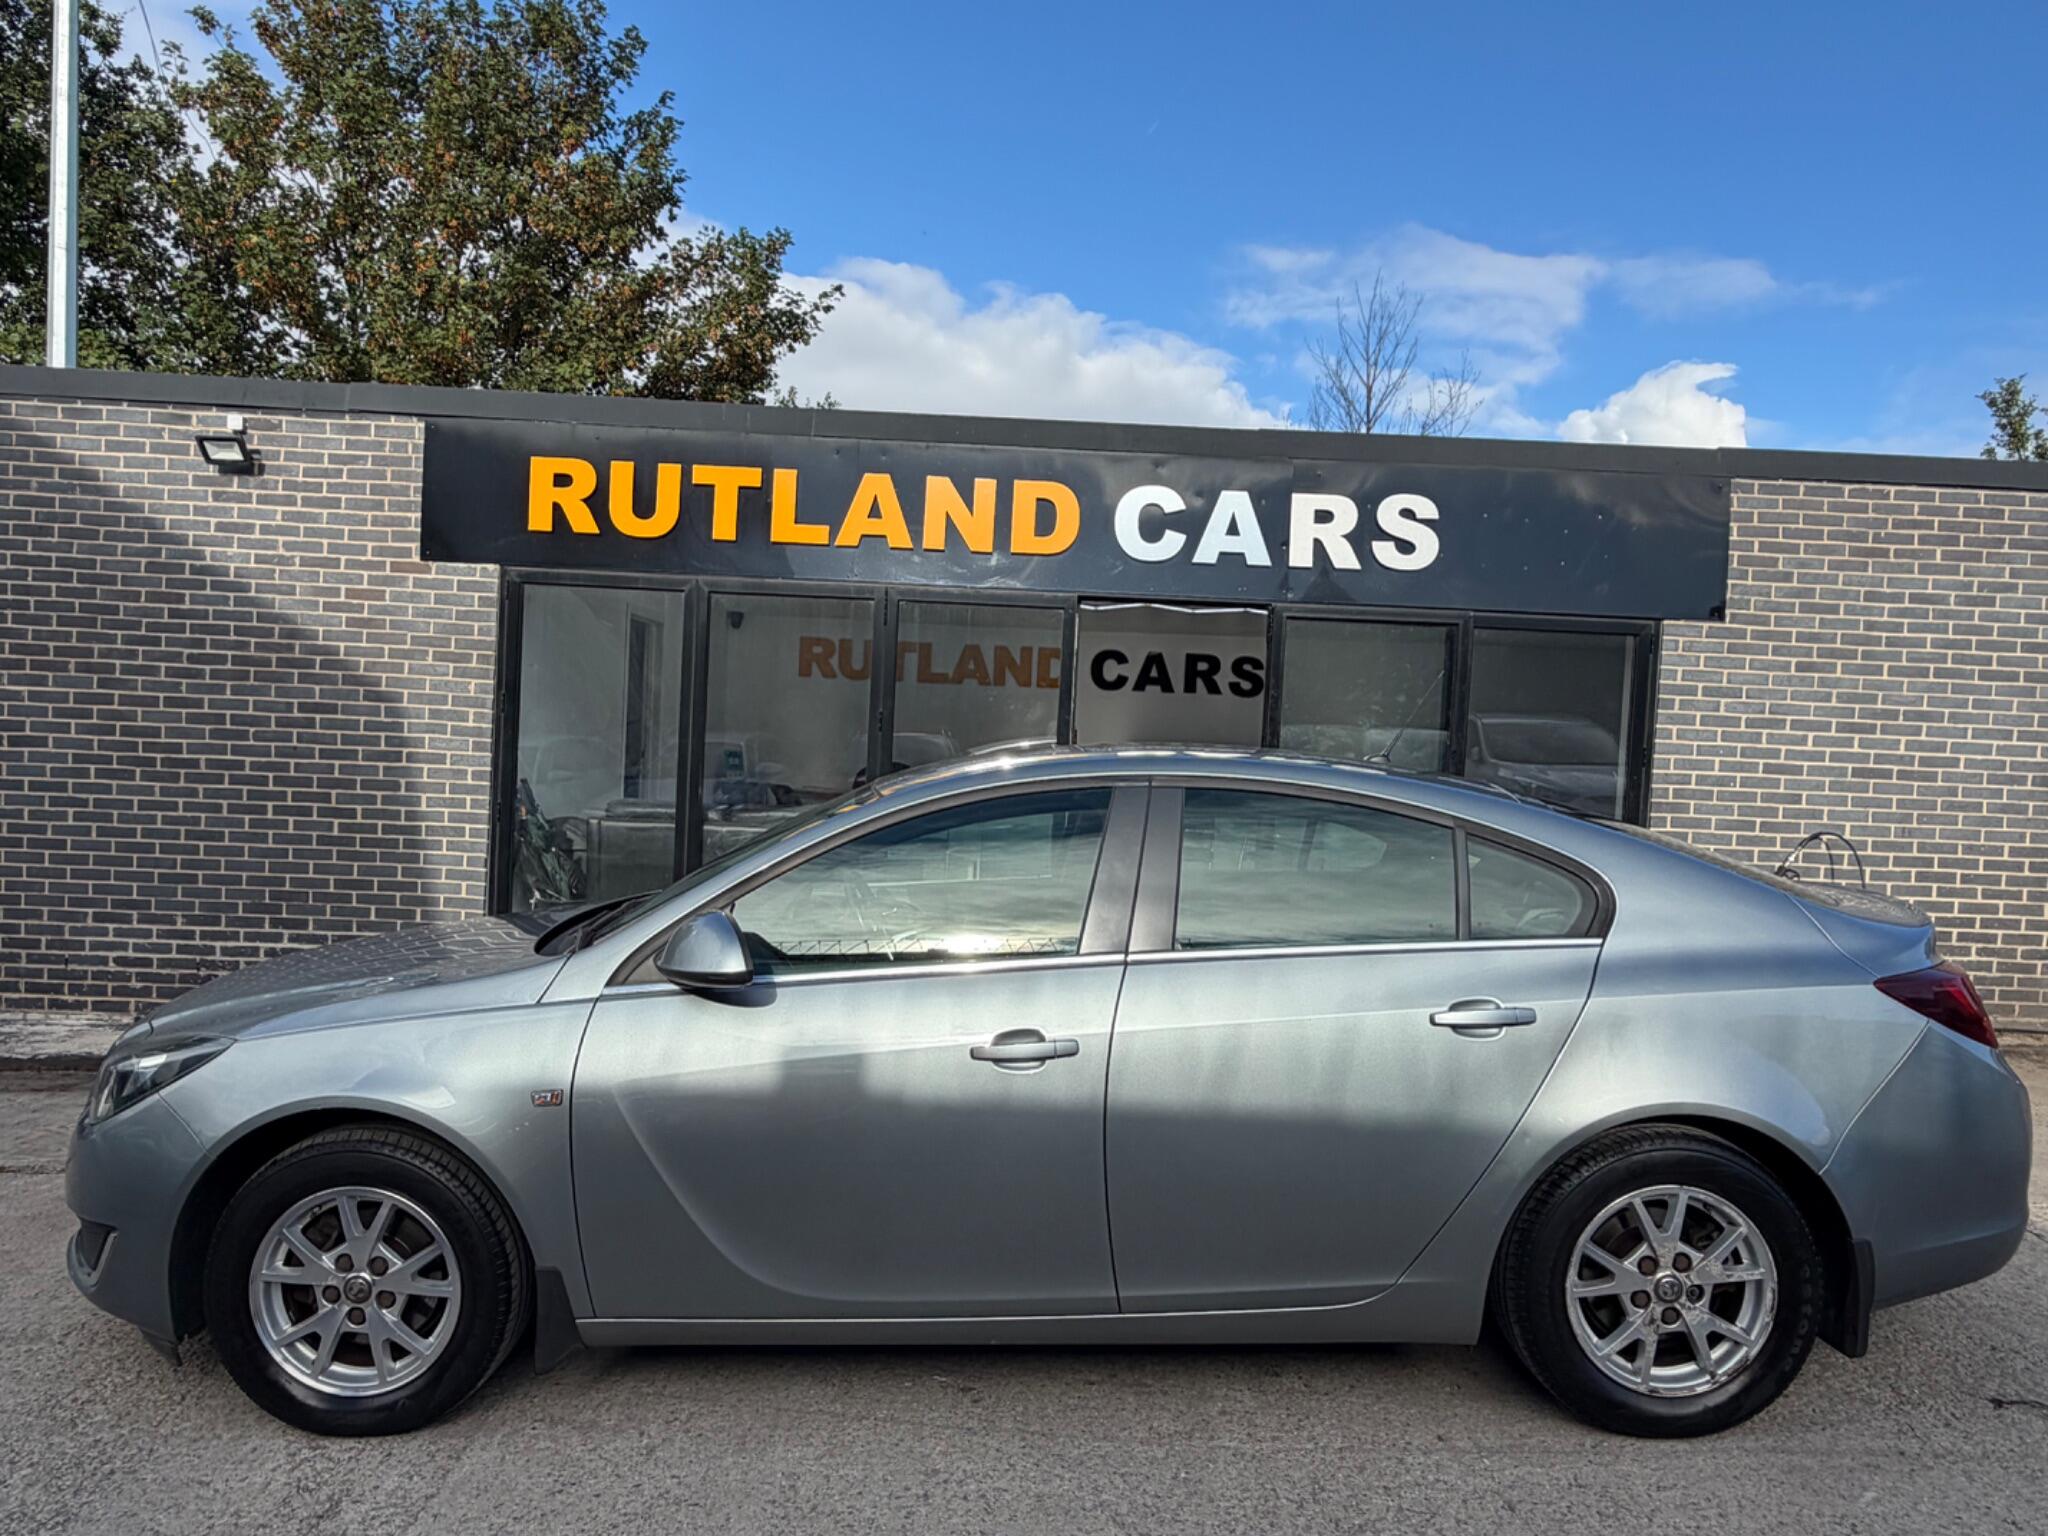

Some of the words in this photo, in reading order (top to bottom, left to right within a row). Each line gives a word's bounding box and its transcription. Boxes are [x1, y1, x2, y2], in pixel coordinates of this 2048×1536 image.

[527, 456, 1081, 556] RUTLAND
[1113, 484, 1440, 572] CARS
[1089, 648, 1265, 699] CARS
